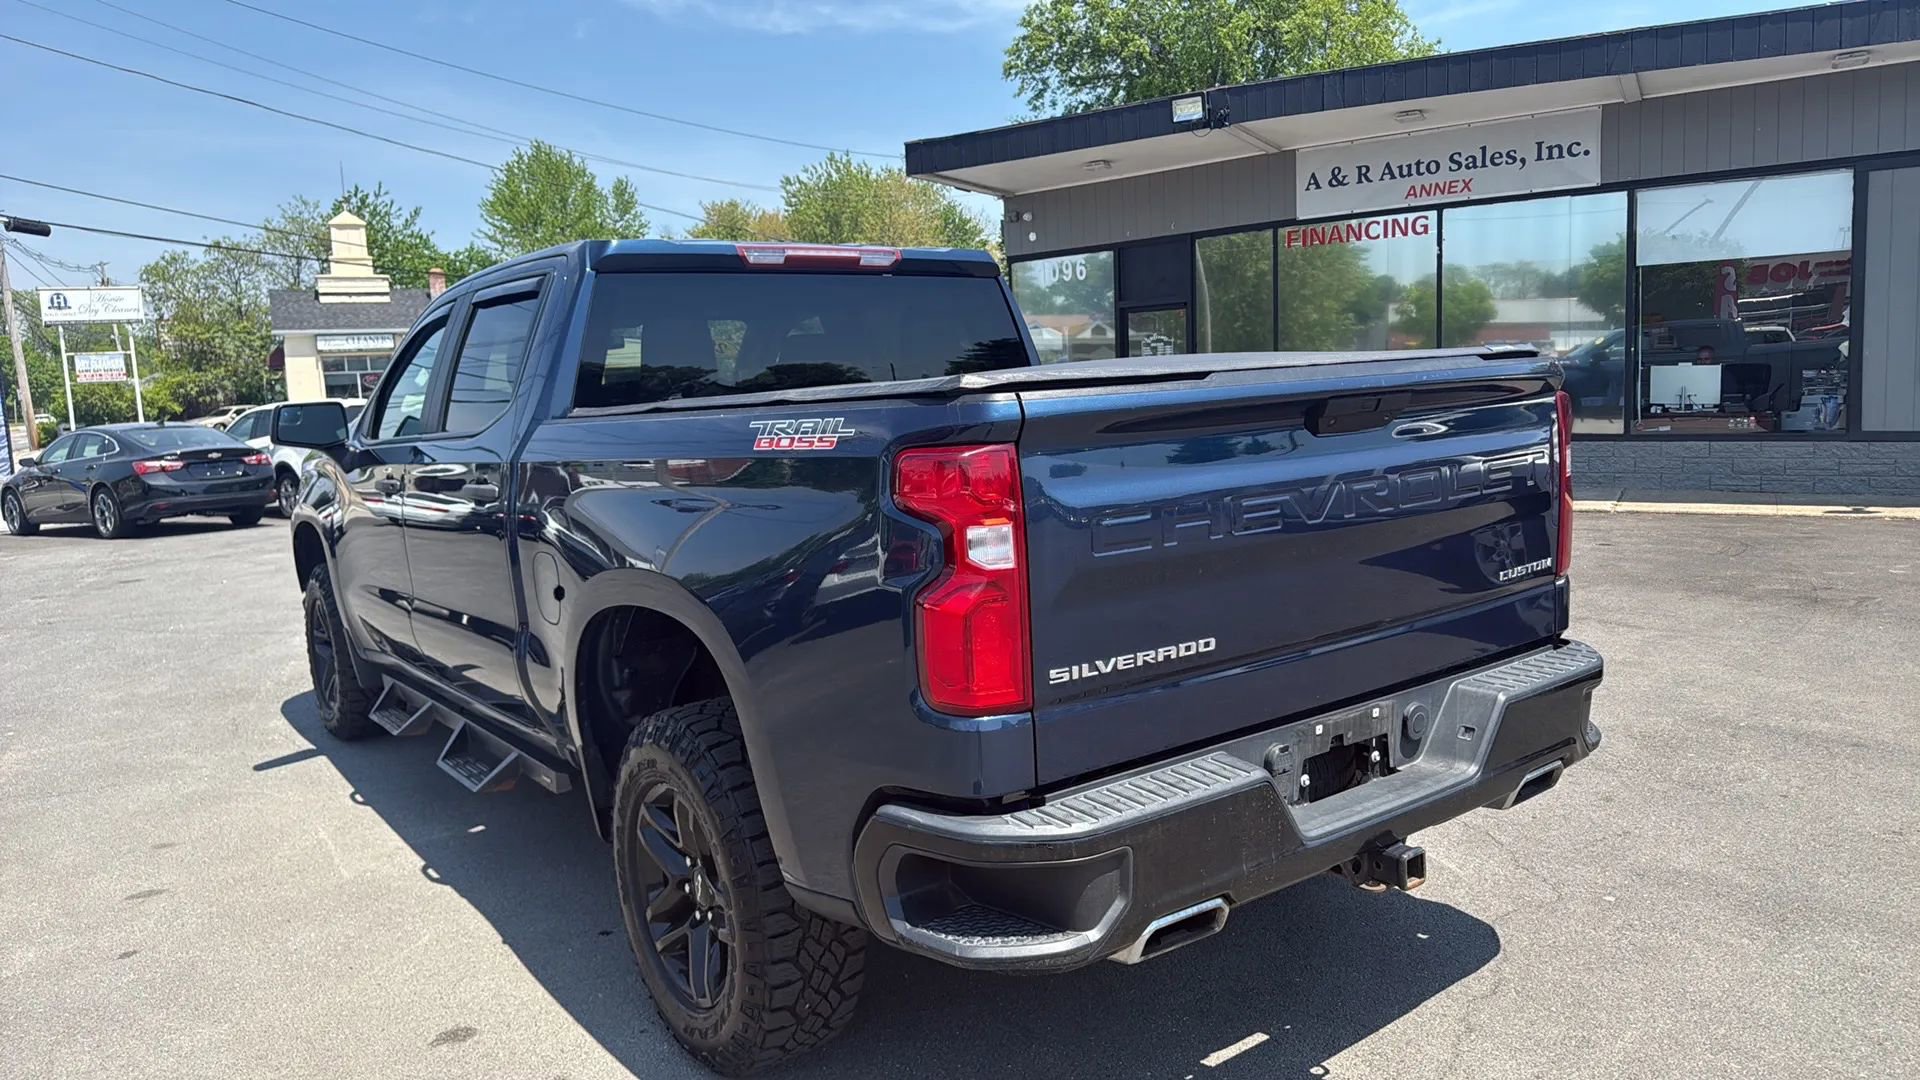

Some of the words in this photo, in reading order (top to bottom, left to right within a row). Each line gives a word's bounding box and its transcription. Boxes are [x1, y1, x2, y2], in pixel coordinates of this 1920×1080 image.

[1304, 172, 1322, 191] A
[1328, 166, 1350, 188] &
[1355, 165, 1374, 185] R
[1378, 159, 1441, 181] Auto
[1448, 145, 1527, 171] Sales,
[1534, 140, 1591, 162] Inc.
[1405, 178, 1473, 199] ANNEX
[1285, 215, 1430, 249] FINANCING
[749, 417, 855, 437] TRAIL
[753, 435, 839, 451] BOSS
[1092, 451, 1549, 557] CHEVROLET
[1499, 557, 1553, 582] CUSTOM
[1049, 637, 1216, 684] SILVERADO
